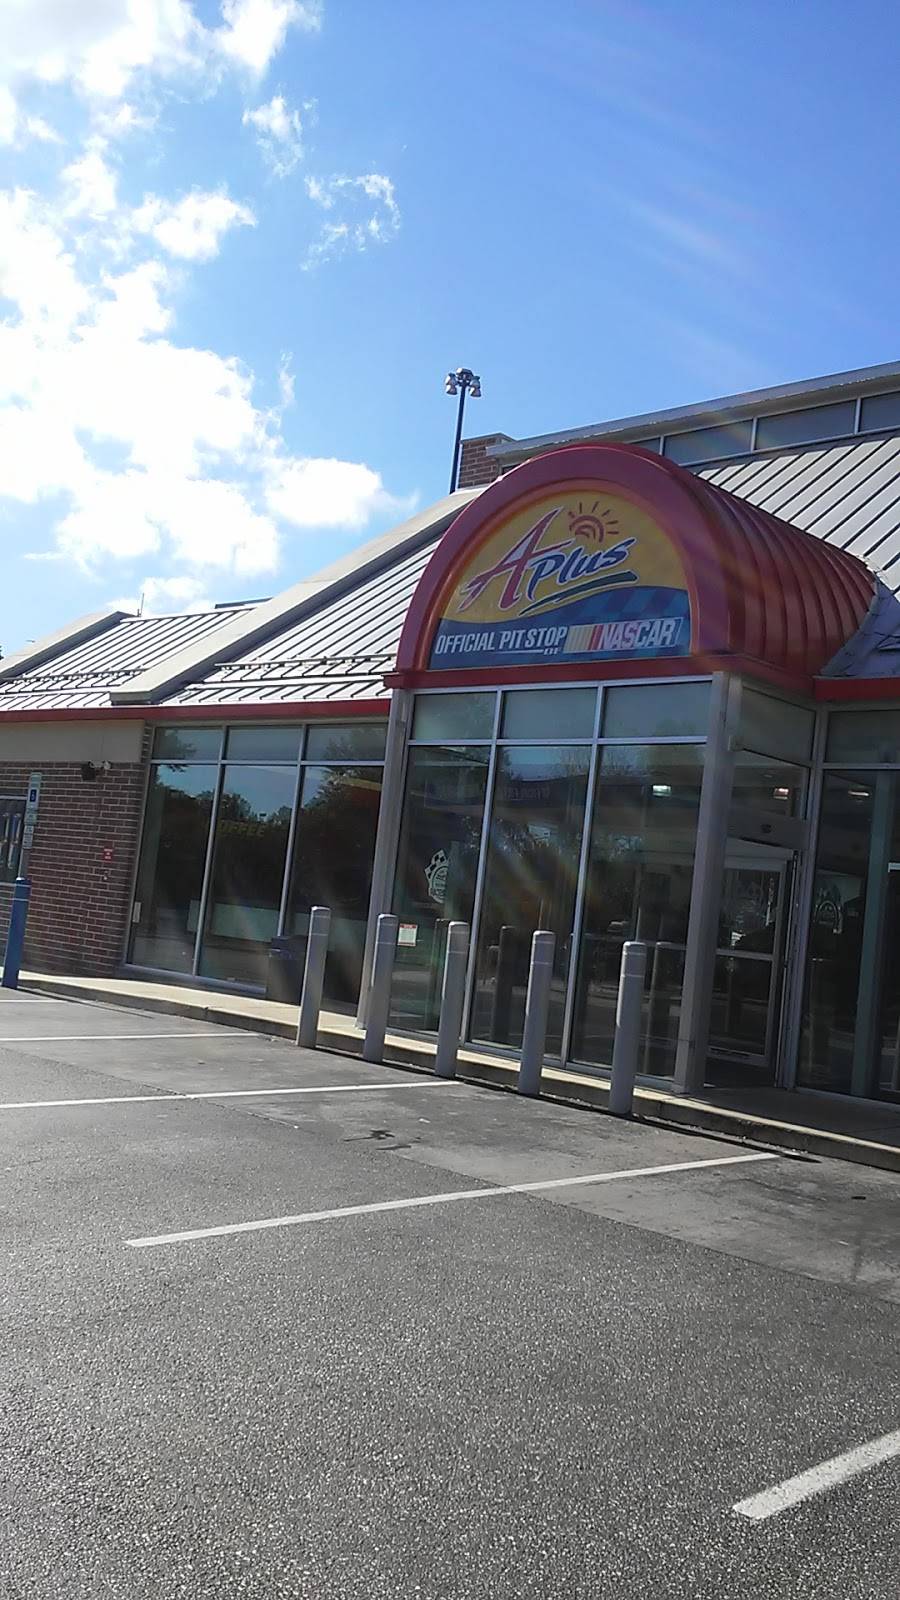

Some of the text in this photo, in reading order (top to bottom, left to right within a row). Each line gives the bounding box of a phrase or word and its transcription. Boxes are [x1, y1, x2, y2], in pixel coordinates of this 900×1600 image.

[435, 619, 677, 655] OFFICIAL PIT STOP NASCAR
